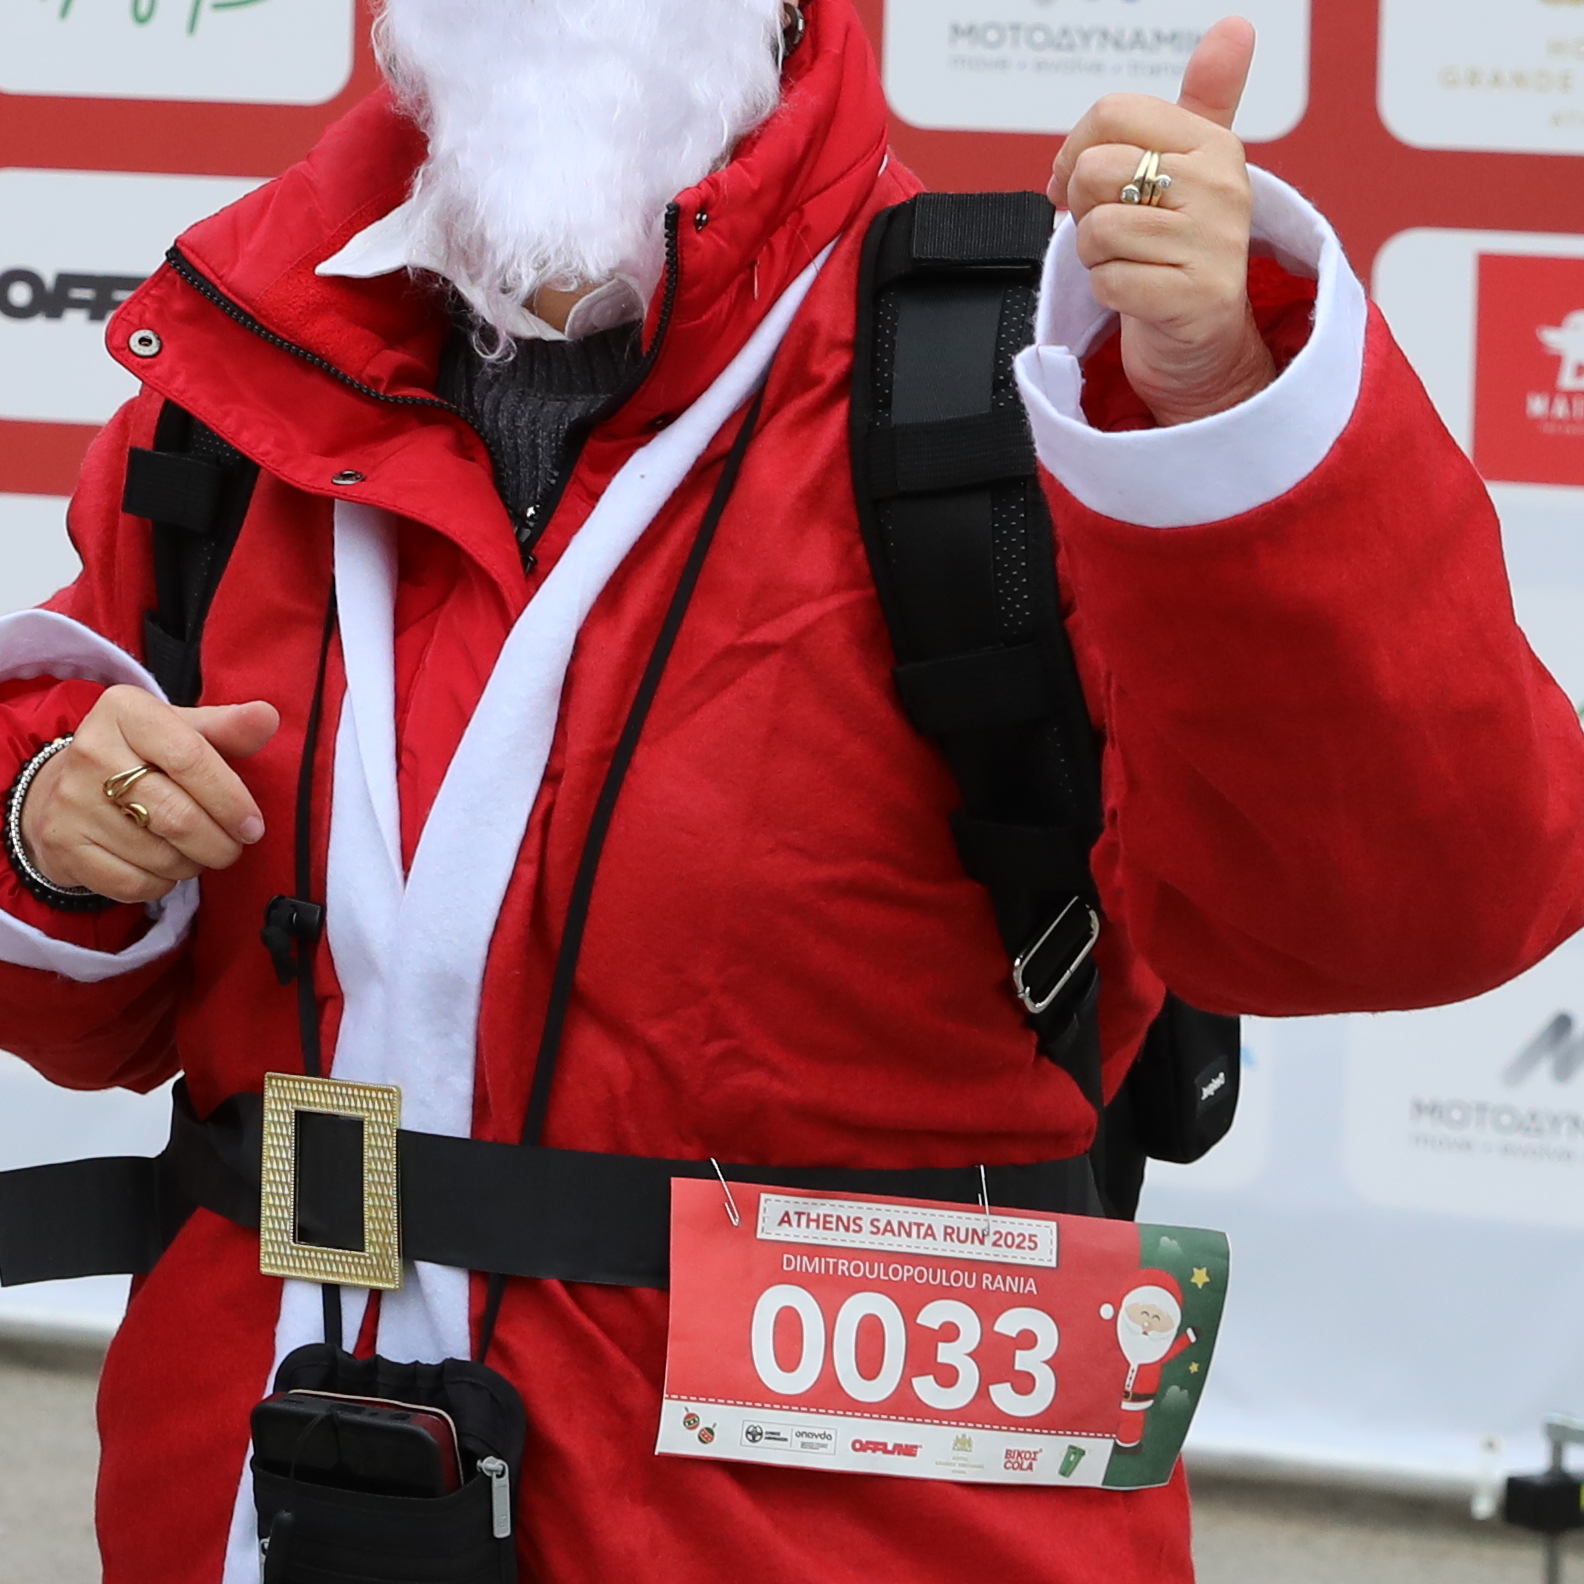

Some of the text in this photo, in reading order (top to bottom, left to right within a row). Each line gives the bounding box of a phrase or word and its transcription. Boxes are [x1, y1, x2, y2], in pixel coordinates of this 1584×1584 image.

[777, 1210, 1039, 1252] ATHENS SANTA RUN 2025
[782, 1253, 1037, 1295] DIMITROULOPOULOU RANIA
[751, 1283, 1059, 1417] 0033
[1003, 1460, 1034, 1472] COLA
[1004, 1449, 1038, 1462] ΒΙΚΟΣ
